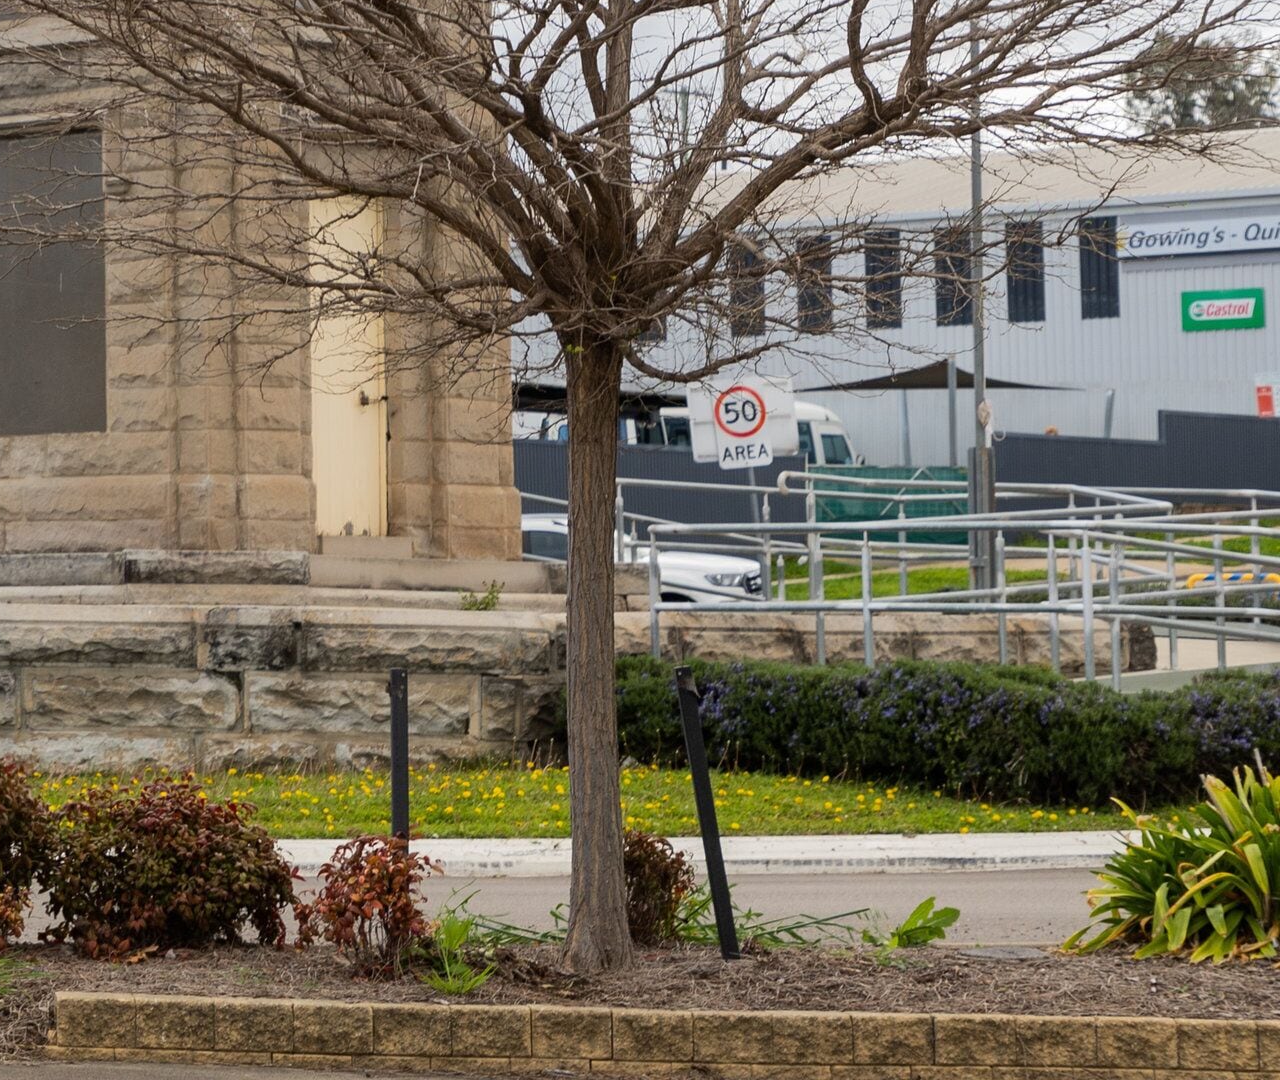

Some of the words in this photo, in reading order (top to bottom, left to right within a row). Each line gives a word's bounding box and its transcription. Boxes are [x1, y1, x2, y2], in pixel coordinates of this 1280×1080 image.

[1129, 225, 1225, 249] Gowing's
[1205, 302, 1250, 317] Castrol
[724, 400, 757, 424] 50
[723, 444, 769, 461] AREA
